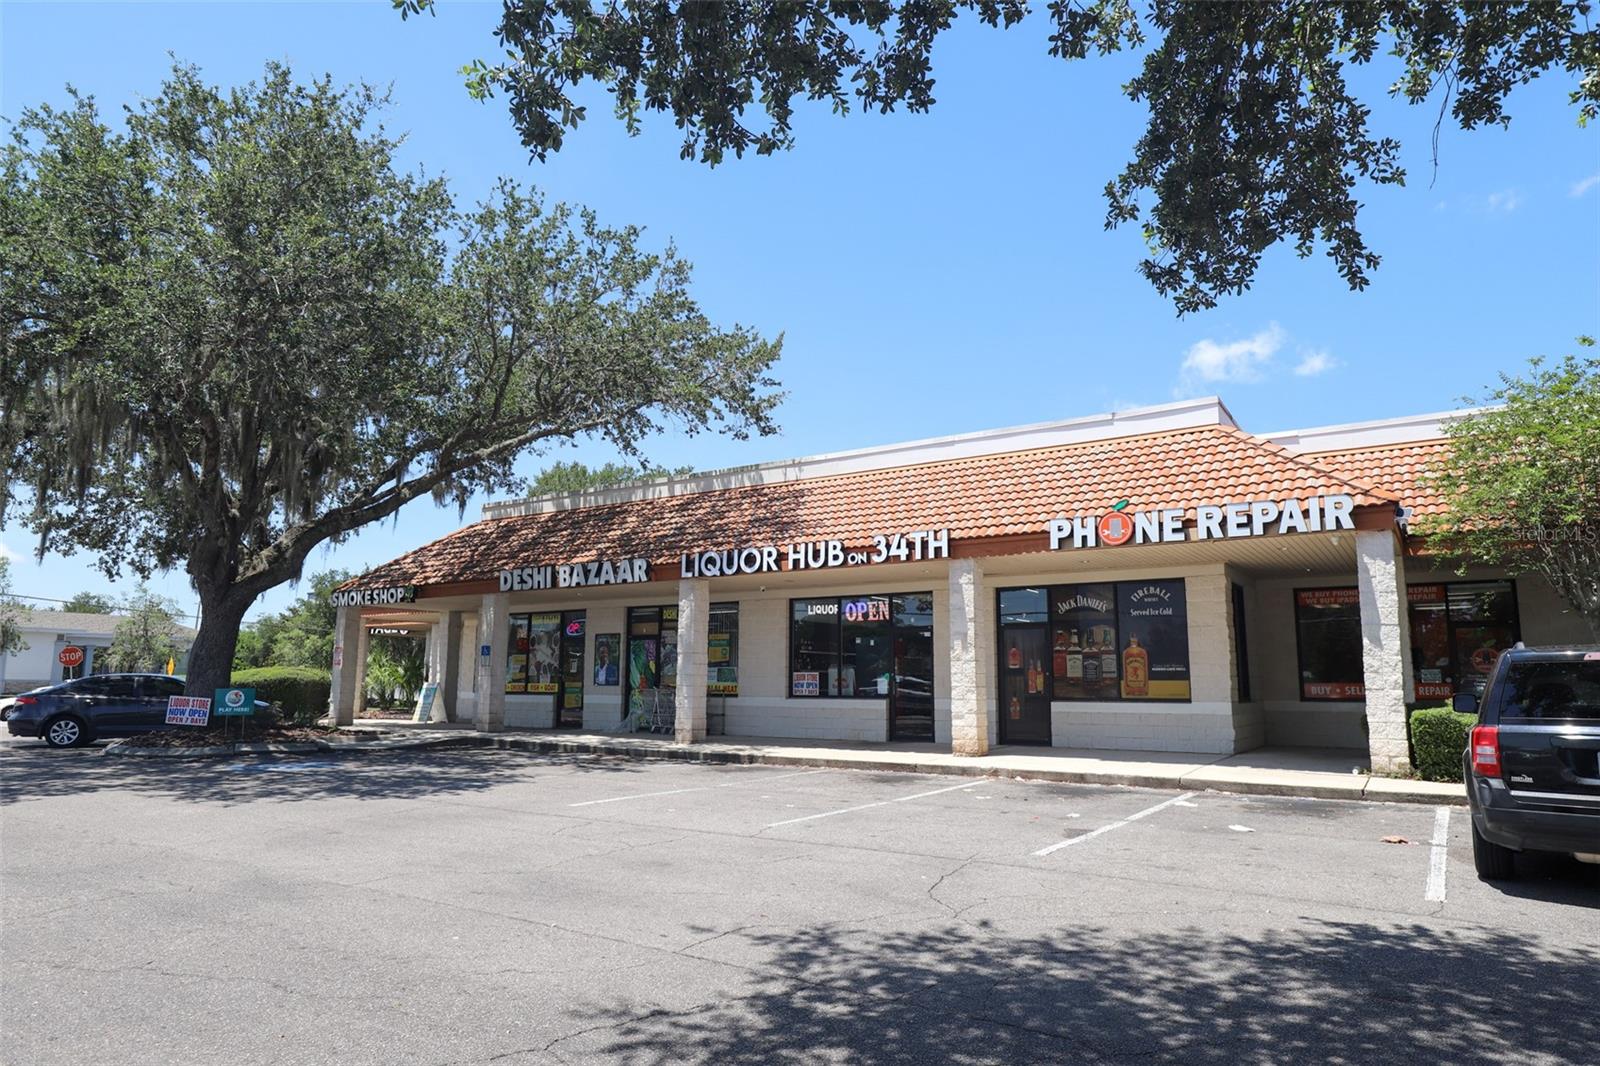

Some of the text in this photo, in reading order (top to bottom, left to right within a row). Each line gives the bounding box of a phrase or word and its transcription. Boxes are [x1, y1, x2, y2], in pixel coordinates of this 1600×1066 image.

[1197, 494, 1355, 540] REPAIR
[681, 528, 949, 578] LIQUOR HUB ON 34TH
[500, 558, 648, 592] DESHI BAZAAR
[331, 587, 405, 607] SMOKE SHOP
[1130, 586, 1171, 602] FIREBALL
[845, 601, 889, 621] OPEN
[1057, 597, 1077, 614] JACK
[1130, 608, 1149, 616] Served
[1160, 607, 1173, 616] Cold
[60, 652, 82, 662] STOP
[1311, 686, 1331, 695] BUY
[1419, 687, 1451, 696] REPAIR
[170, 697, 209, 709] LIQUOR STORE
[168, 708, 208, 718] NOW OPEN
